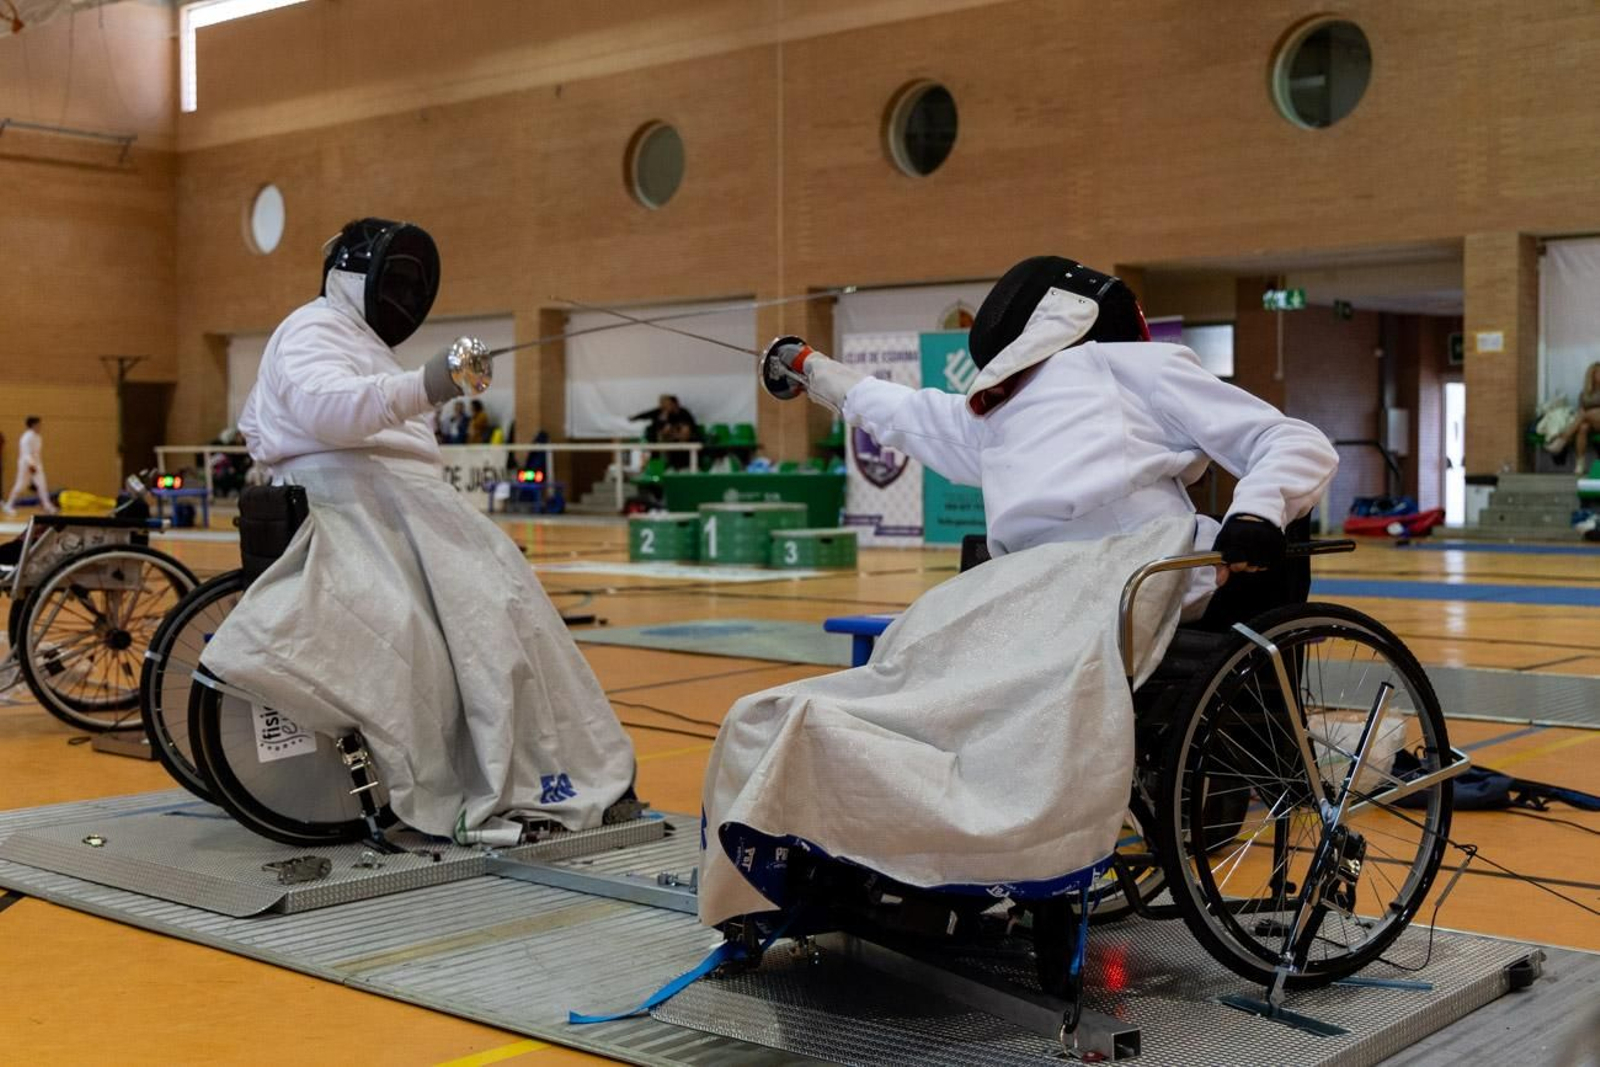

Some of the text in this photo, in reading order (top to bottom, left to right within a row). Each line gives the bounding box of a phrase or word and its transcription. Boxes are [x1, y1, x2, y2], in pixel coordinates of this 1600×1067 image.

[640, 529, 655, 554] 2
[703, 516, 718, 558] 1
[784, 541, 798, 564] 3
